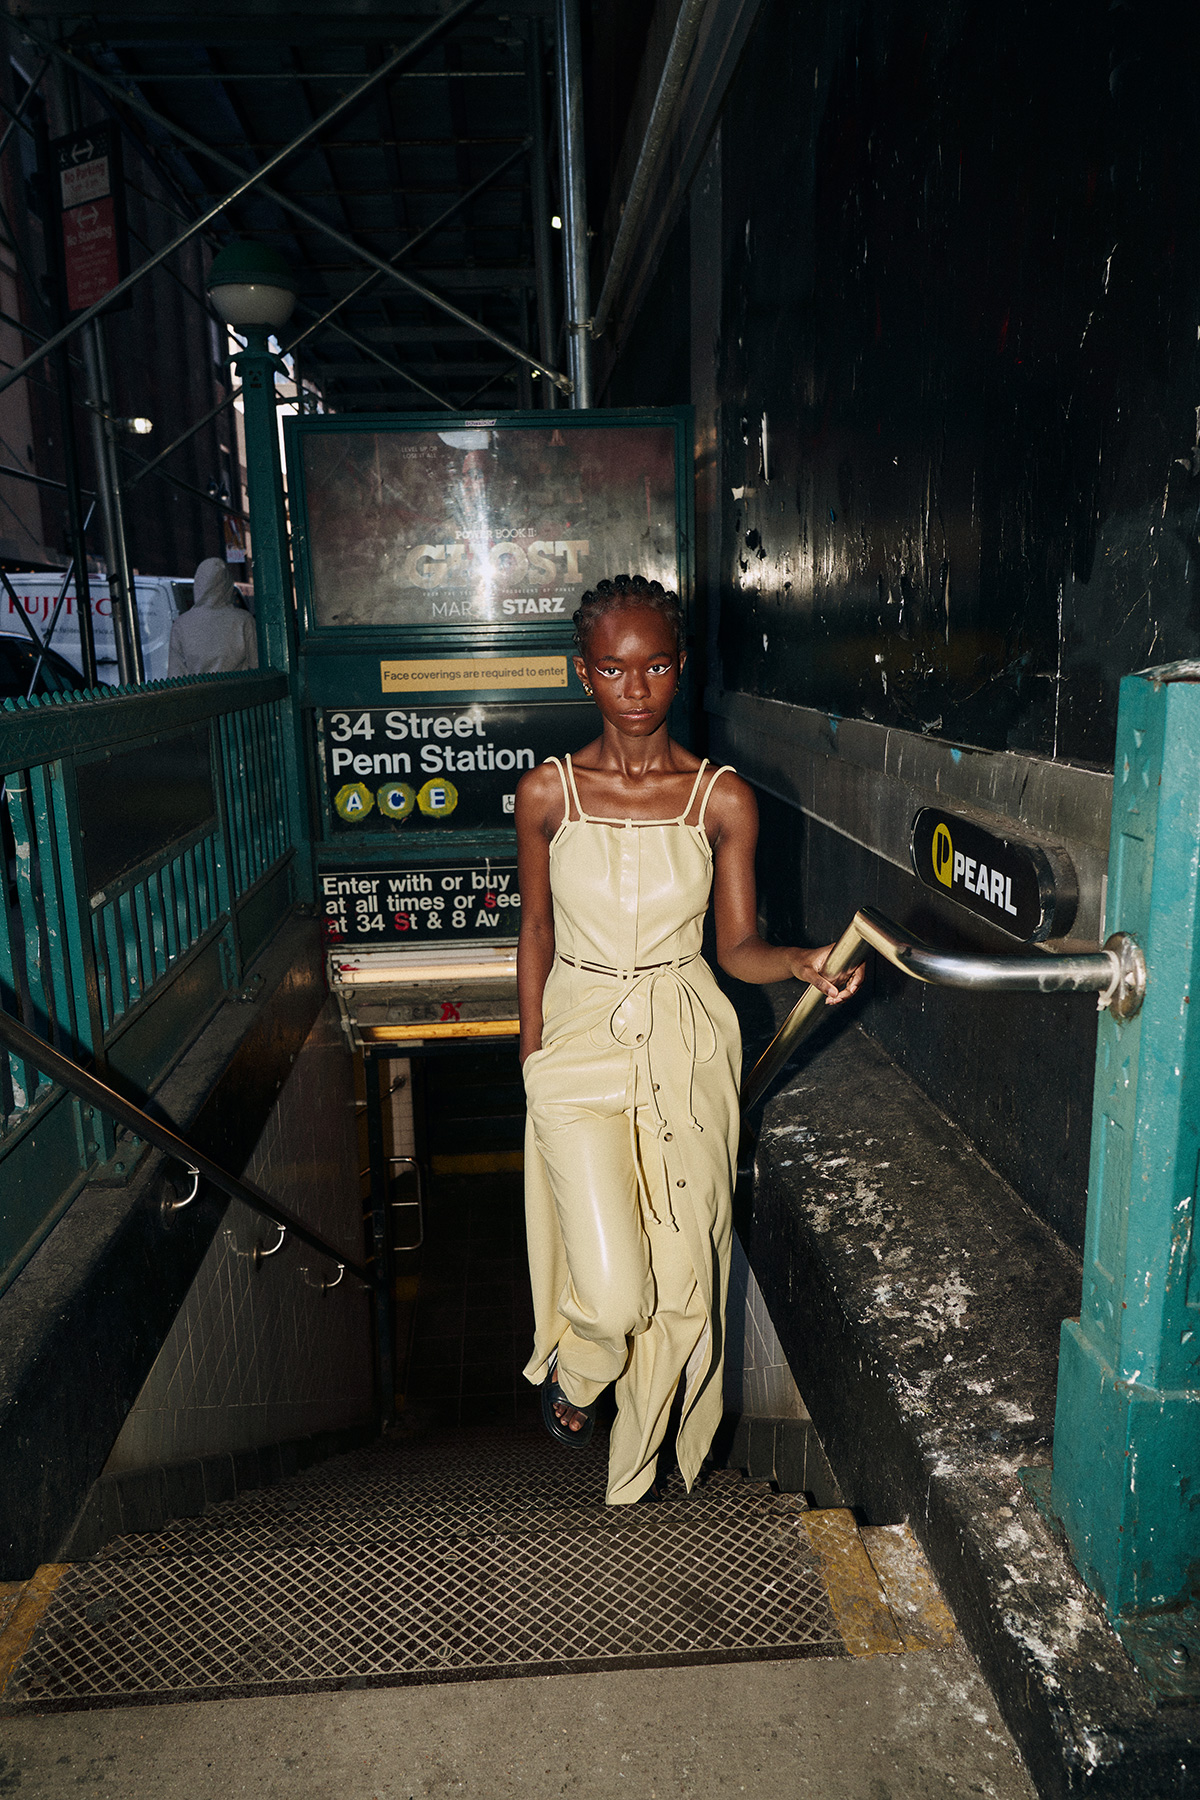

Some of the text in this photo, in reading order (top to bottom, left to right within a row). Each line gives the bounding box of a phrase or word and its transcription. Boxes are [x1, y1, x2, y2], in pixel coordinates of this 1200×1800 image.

[66, 235, 77, 247] No
[78, 226, 112, 244] Standing
[495, 528, 526, 539] BOOK
[8, 596, 112, 622] FUJITC
[432, 602, 472, 617] MAR
[502, 597, 566, 615] STARZ
[384, 667, 565, 681] Face coverings are required to enter
[330, 711, 486, 742] 34 Street
[331, 743, 535, 776] Penn Station
[346, 788, 446, 812] A C E
[322, 871, 511, 896] Enter with or buy
[953, 850, 1018, 917] PEARL
[325, 892, 522, 915] at all times or see
[327, 909, 500, 934] at 34 St & 8 Av
